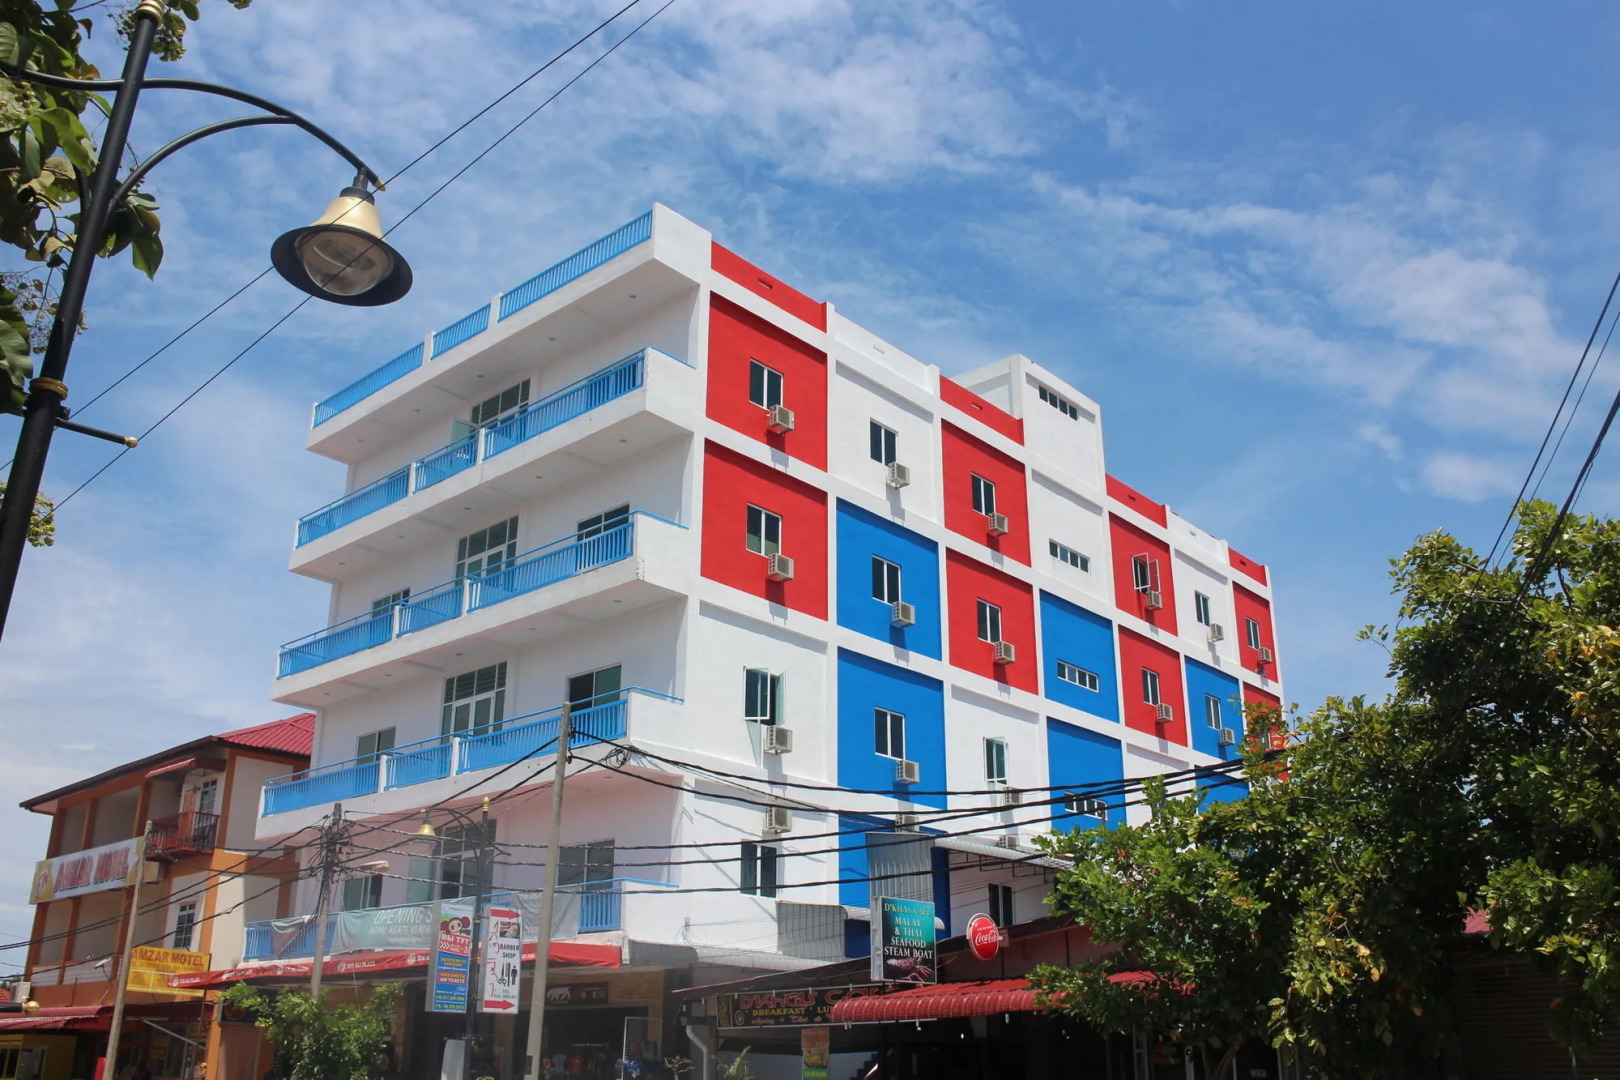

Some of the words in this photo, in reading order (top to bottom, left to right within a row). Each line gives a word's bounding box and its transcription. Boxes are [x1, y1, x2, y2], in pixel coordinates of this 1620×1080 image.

[54, 855, 93, 892] AMZAR
[94, 847, 130, 885] MOTEL
[374, 906, 424, 925] OPENING
[894, 916, 921, 927] MALAY
[894, 927, 900, 936] &
[904, 928, 922, 938] THAI
[456, 936, 470, 945] ТУТ
[890, 937, 926, 948] SEAFOOD
[500, 943, 520, 952] BARBER
[884, 946, 911, 957] STEAM
[912, 949, 933, 959] BOAT
[132, 948, 169, 963] AMZAR
[171, 953, 204, 967] MOTEL
[752, 1007, 806, 1016] BREAKFAST
